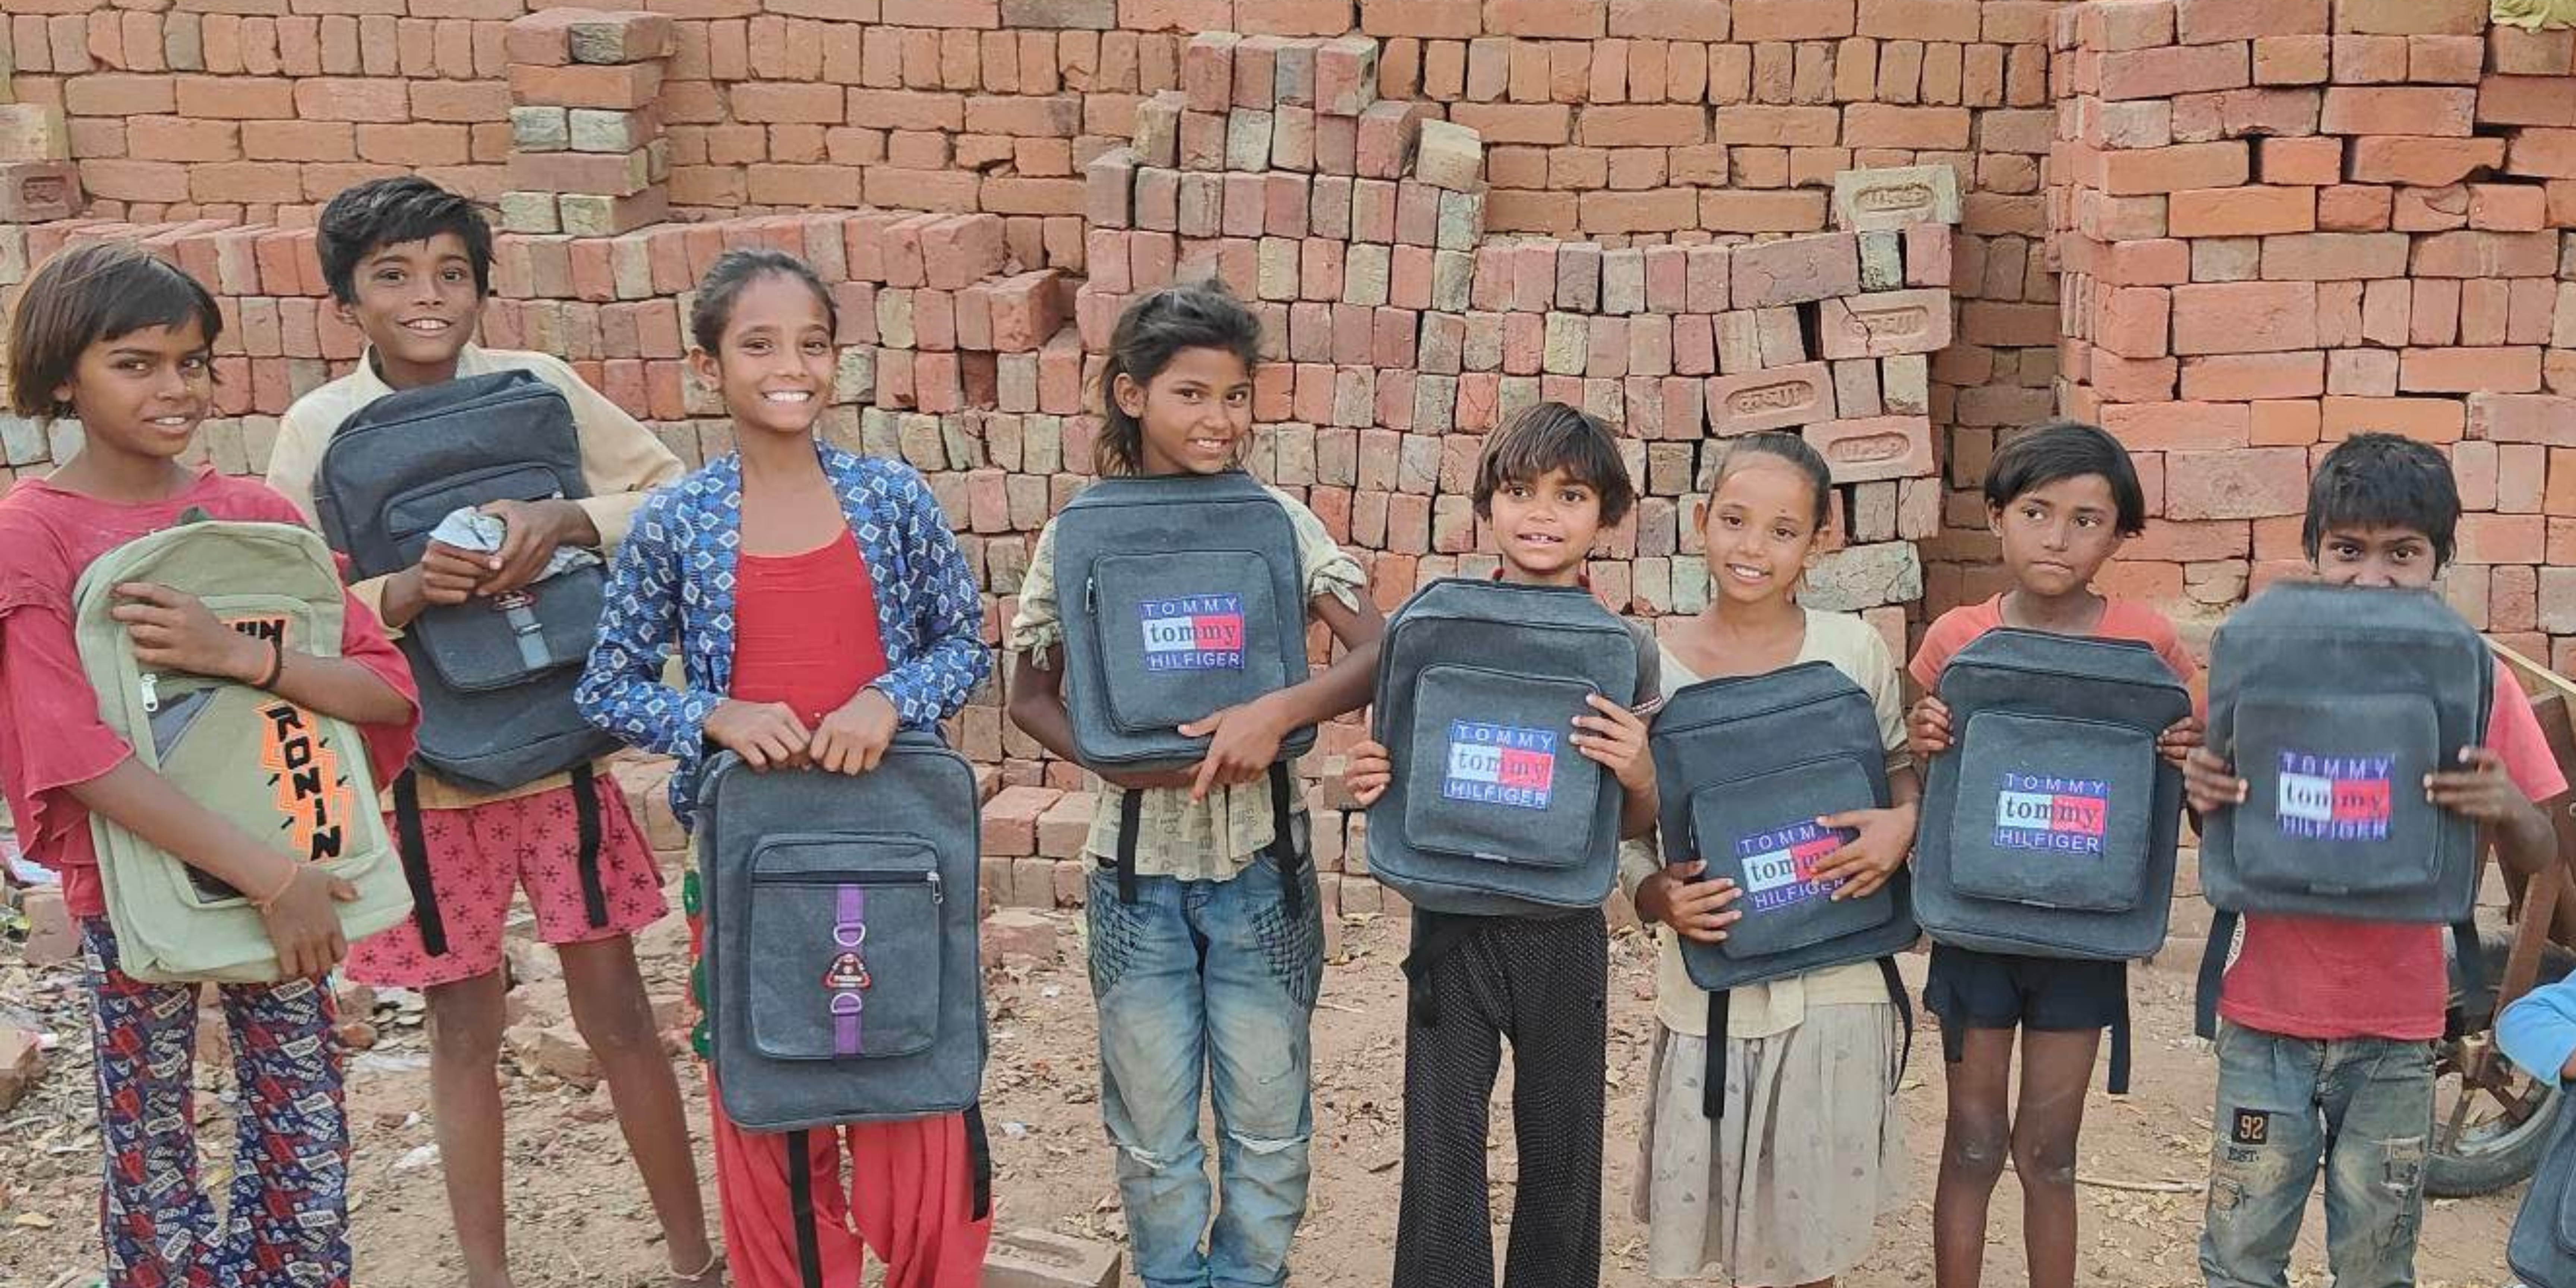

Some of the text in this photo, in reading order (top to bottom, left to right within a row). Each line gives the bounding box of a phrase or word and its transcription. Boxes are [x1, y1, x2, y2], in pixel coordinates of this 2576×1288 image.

[1144, 597, 1237, 616] TOMMY
[1150, 623, 1236, 645] tommy
[1150, 653, 1240, 667] HILFIGER
[1458, 725, 1553, 749] TOMMY
[2283, 751, 2388, 779] TOMMY
[266, 705, 341, 861] RONIN
[1451, 781, 1547, 809] HILFIGER
[2006, 773, 2104, 793] TOMMY
[2007, 796, 2098, 828] tommy
[2000, 829, 2099, 852] HILFIGER
[2240, 1115, 2264, 1139] 92
